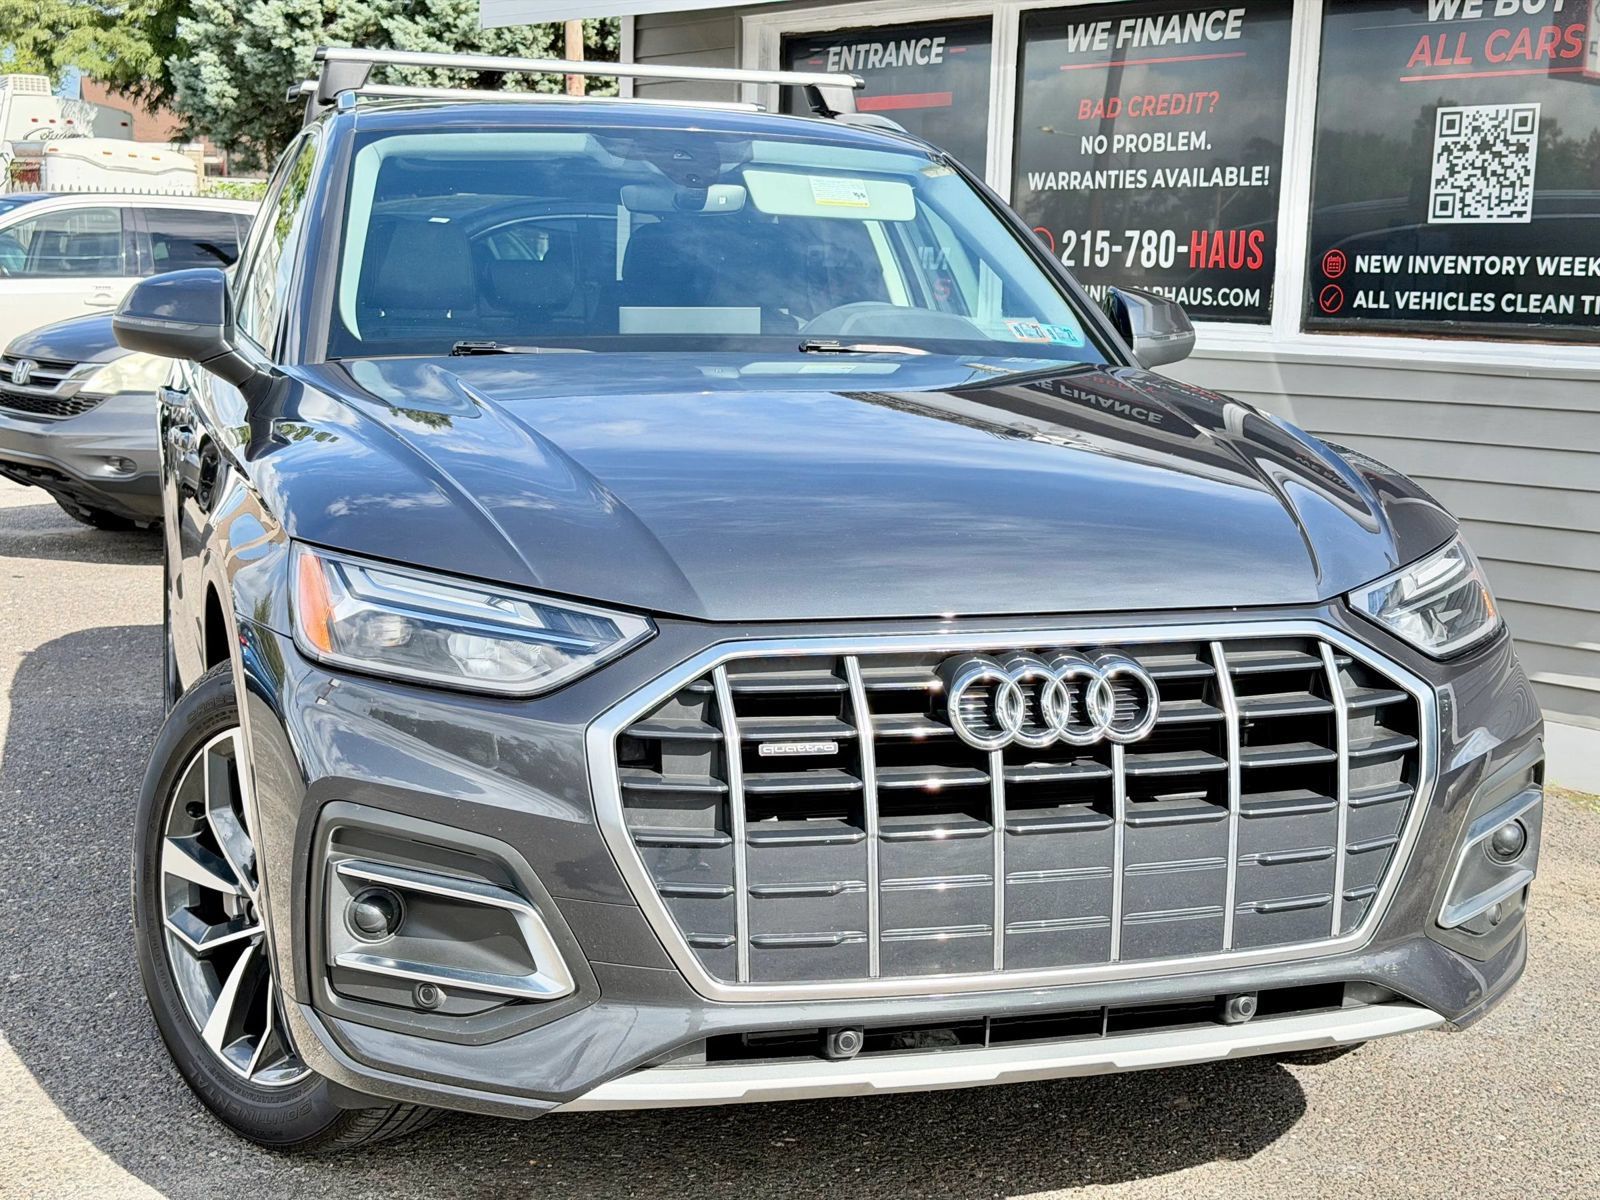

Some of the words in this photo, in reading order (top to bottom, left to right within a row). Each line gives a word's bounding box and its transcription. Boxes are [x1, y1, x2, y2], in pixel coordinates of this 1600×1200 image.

[1427, 0, 1483, 22] WE
[1066, 20, 1112, 53] WE
[1116, 8, 1246, 49] FINANCE
[826, 36, 946, 73] ENTRANCE
[1406, 31, 1473, 68] ALL
[1484, 23, 1586, 64] CARS
[1078, 97, 1123, 120] BAD
[1128, 91, 1220, 118] CREDIT?
[1080, 135, 1108, 155] NO
[1113, 131, 1211, 153] PROBLEM.
[1028, 169, 1147, 191] WARRANTIES
[1151, 166, 1270, 188] AVAILABLE!
[1061, 229, 1265, 269] 215-780-HAUS
[1355, 254, 1403, 274] NEW
[1407, 254, 1531, 275] INVENTORY
[1536, 256, 1600, 277] WEEK
[1353, 290, 1390, 309] ALL
[1395, 291, 1496, 313] VEHICLES
[1500, 293, 1575, 315] CLEAN
[761, 743, 836, 755] quattro
